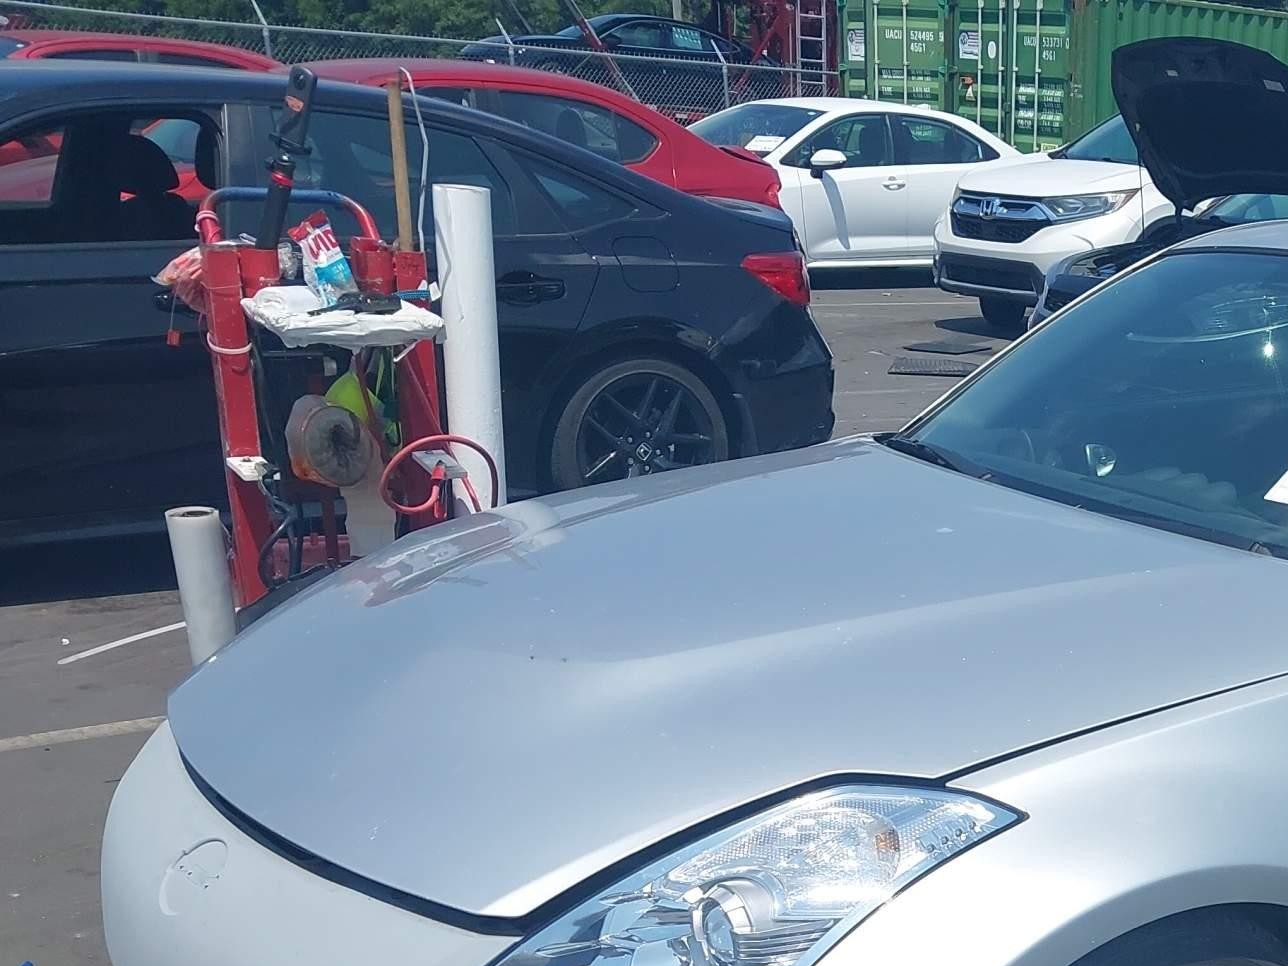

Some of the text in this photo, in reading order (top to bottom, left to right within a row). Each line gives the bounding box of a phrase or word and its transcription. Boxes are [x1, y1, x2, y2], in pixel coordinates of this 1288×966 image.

[910, 30, 934, 42] 524495
[910, 42, 926, 53] 45G1
[1042, 37, 1063, 48] 533731
[1042, 50, 1056, 61] 45G1
